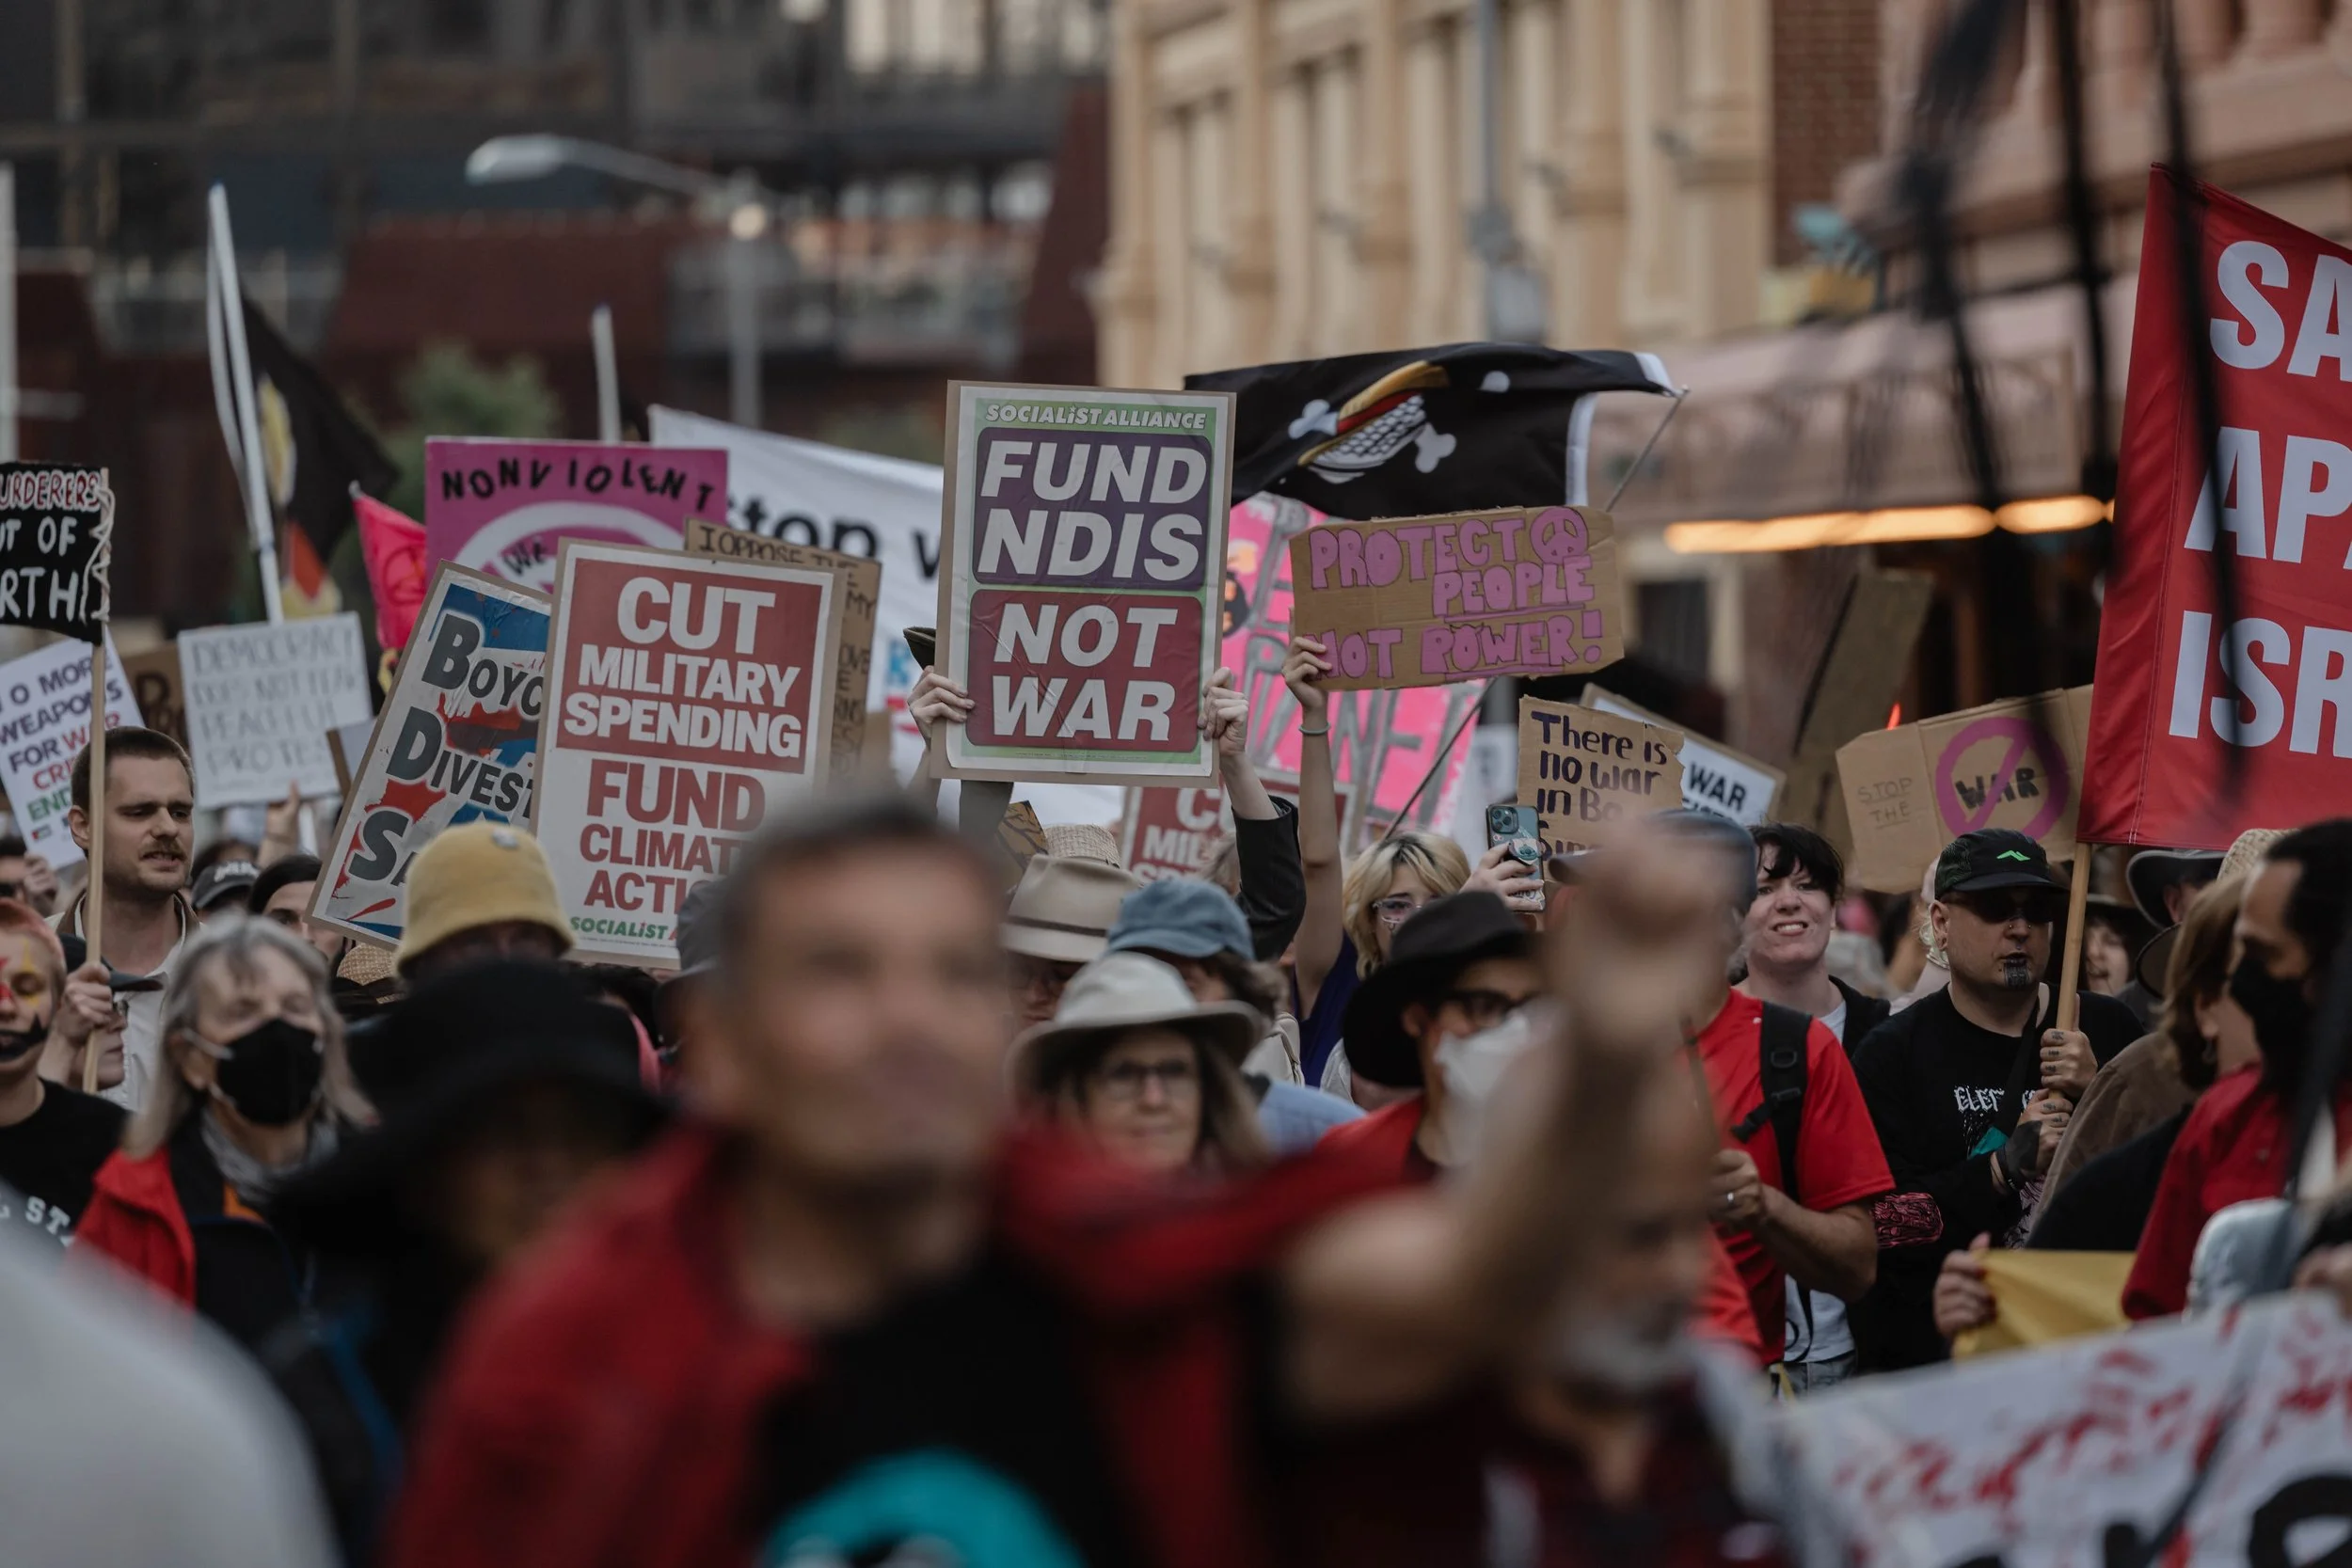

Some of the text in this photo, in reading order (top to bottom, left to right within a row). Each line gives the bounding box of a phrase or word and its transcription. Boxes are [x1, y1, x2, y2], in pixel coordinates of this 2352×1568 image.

[1103, 408, 1207, 430] ALLIANCE
[980, 440, 1207, 504] FUND
[2184, 426, 2352, 570] AP
[38, 515, 77, 557] OF
[977, 508, 1203, 582] NDIS
[1309, 518, 1524, 591] PROTECT
[617, 577, 776, 655] CUT
[1433, 555, 1596, 617] PEOPLE
[421, 613, 545, 717] BOYC
[993, 603, 1179, 668] NOT
[1421, 610, 1603, 675] POWER!
[38, 656, 113, 696] MOR
[578, 644, 801, 707] MILITARY
[2169, 610, 2352, 759] ISR
[564, 692, 803, 758] SPENDING
[992, 675, 1177, 741] WAR
[1531, 710, 1668, 766] There is
[8, 737, 62, 774] FOR
[62, 711, 121, 752] WR
[1540, 750, 1662, 796] no war
[586, 758, 766, 832] FUND
[1689, 763, 1748, 813] WAR
[1858, 776, 1913, 801] STOP
[1869, 800, 1911, 823] THE
[1954, 767, 2040, 810] WAR
[580, 823, 750, 876] CLIMAT
[583, 869, 689, 915] ACTI
